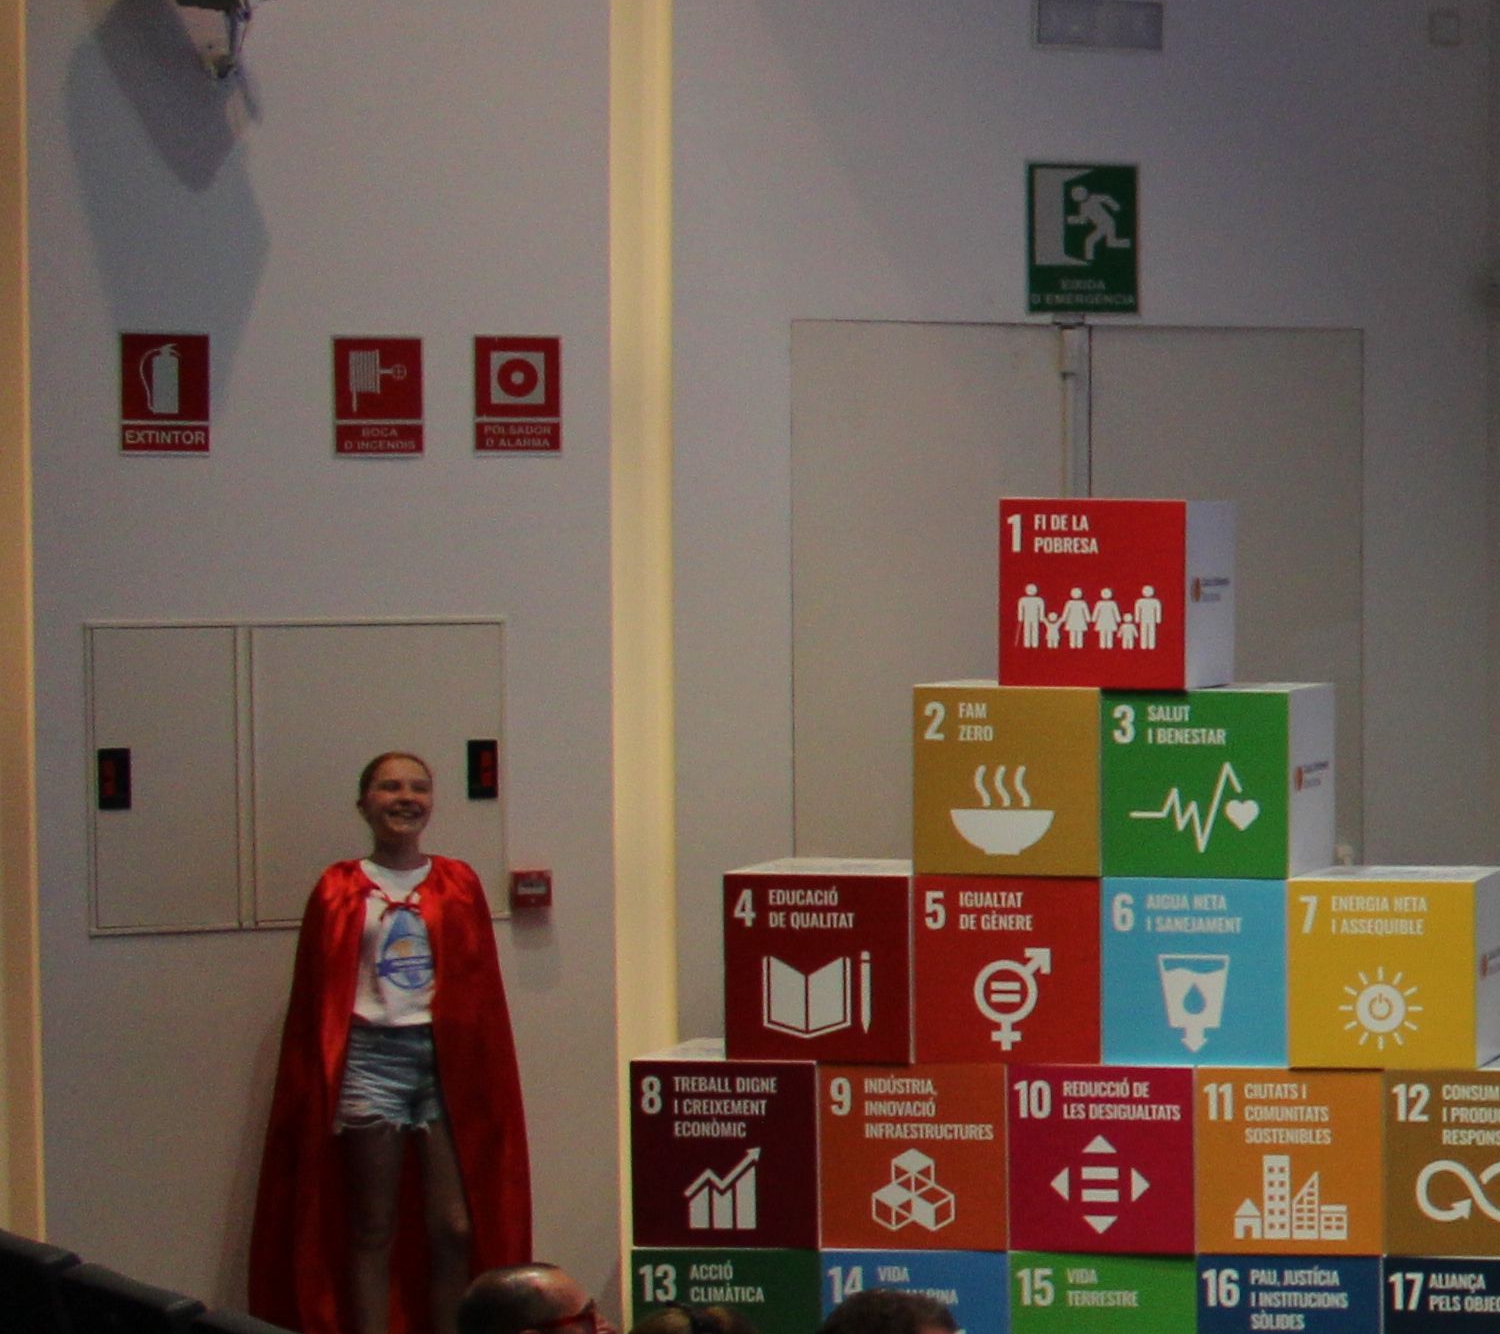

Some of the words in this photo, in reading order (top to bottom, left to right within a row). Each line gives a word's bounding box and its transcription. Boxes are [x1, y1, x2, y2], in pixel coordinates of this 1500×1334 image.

[124, 430, 206, 445] EXTINTOR
[361, 427, 398, 438] BOCA
[1033, 514, 1047, 530] FI
[1051, 515, 1069, 530] DE
[1072, 515, 1089, 531] LA
[1007, 514, 1022, 553] 1
[1033, 537, 1099, 554] POBRESA
[958, 703, 987, 718] FAM
[1148, 705, 1190, 722] SALUT
[923, 701, 946, 740] 2
[1113, 704, 1135, 744] 3
[958, 725, 994, 742] ZERO
[1156, 728, 1226, 745] BENESTAR
[768, 886, 838, 906] EDUCACIÓ
[959, 891, 1023, 908] IGUALTAT
[1146, 894, 1190, 910] AIGUA
[1193, 895, 1227, 911] NETA
[1331, 895, 1389, 912] ENERGIA
[1393, 896, 1427, 912] NETA
[734, 889, 755, 927] 4
[924, 891, 946, 930] 5
[1112, 893, 1135, 932] 6
[1299, 895, 1318, 934] 7
[769, 913, 786, 928] DE
[790, 913, 855, 929] QUALITAT
[959, 914, 977, 930] DE
[981, 911, 1034, 931] GÈNERE
[1154, 917, 1244, 934] SANEJAMENT
[1340, 919, 1425, 936] ASSEQUIBLE
[673, 1077, 732, 1093] TREBALL
[736, 1077, 778, 1093] DIGNE
[1063, 1077, 1129, 1098] REDUCCIÓ
[1133, 1081, 1149, 1098] DE
[1244, 1083, 1298, 1099] CIUTATS
[1442, 1084, 1500, 1100] CONSUM
[641, 1076, 662, 1114] 8
[830, 1077, 852, 1115] 9
[1014, 1080, 1051, 1119] 10
[1203, 1083, 1234, 1121] 11
[1392, 1083, 1431, 1122] 12
[683, 1099, 767, 1116] CREIXEMENT
[864, 1098, 936, 1117] INNOVACIÓ
[1063, 1104, 1087, 1119] LES
[1089, 1104, 1181, 1121] DESIGUALTATS
[1244, 1106, 1329, 1122] COMUNITATS
[674, 1118, 747, 1138] ECONÒMIC
[864, 1123, 994, 1141] INFRAESTRUCTURES
[1244, 1127, 1332, 1145] SOSTENIBLES
[689, 1260, 734, 1281] ACCIÓ
[877, 1266, 911, 1283] VIDA
[1066, 1268, 1098, 1284] VIDA
[1282, 1266, 1339, 1287] JUSTÍCIA
[638, 1264, 677, 1303] 13
[827, 1266, 863, 1305] 14
[1015, 1268, 1055, 1308] 15
[1202, 1268, 1241, 1308] 16
[1388, 1272, 1424, 1311] 17
[1428, 1273, 1486, 1294] ALIANÇA
[689, 1283, 765, 1304] CLIMÀTICA
[1066, 1290, 1139, 1308] TERRESTRE
[1259, 1292, 1348, 1309] INSTITUCIONS
[1429, 1295, 1461, 1312] PELS
[1251, 1309, 1305, 1331] SÒLIDES
